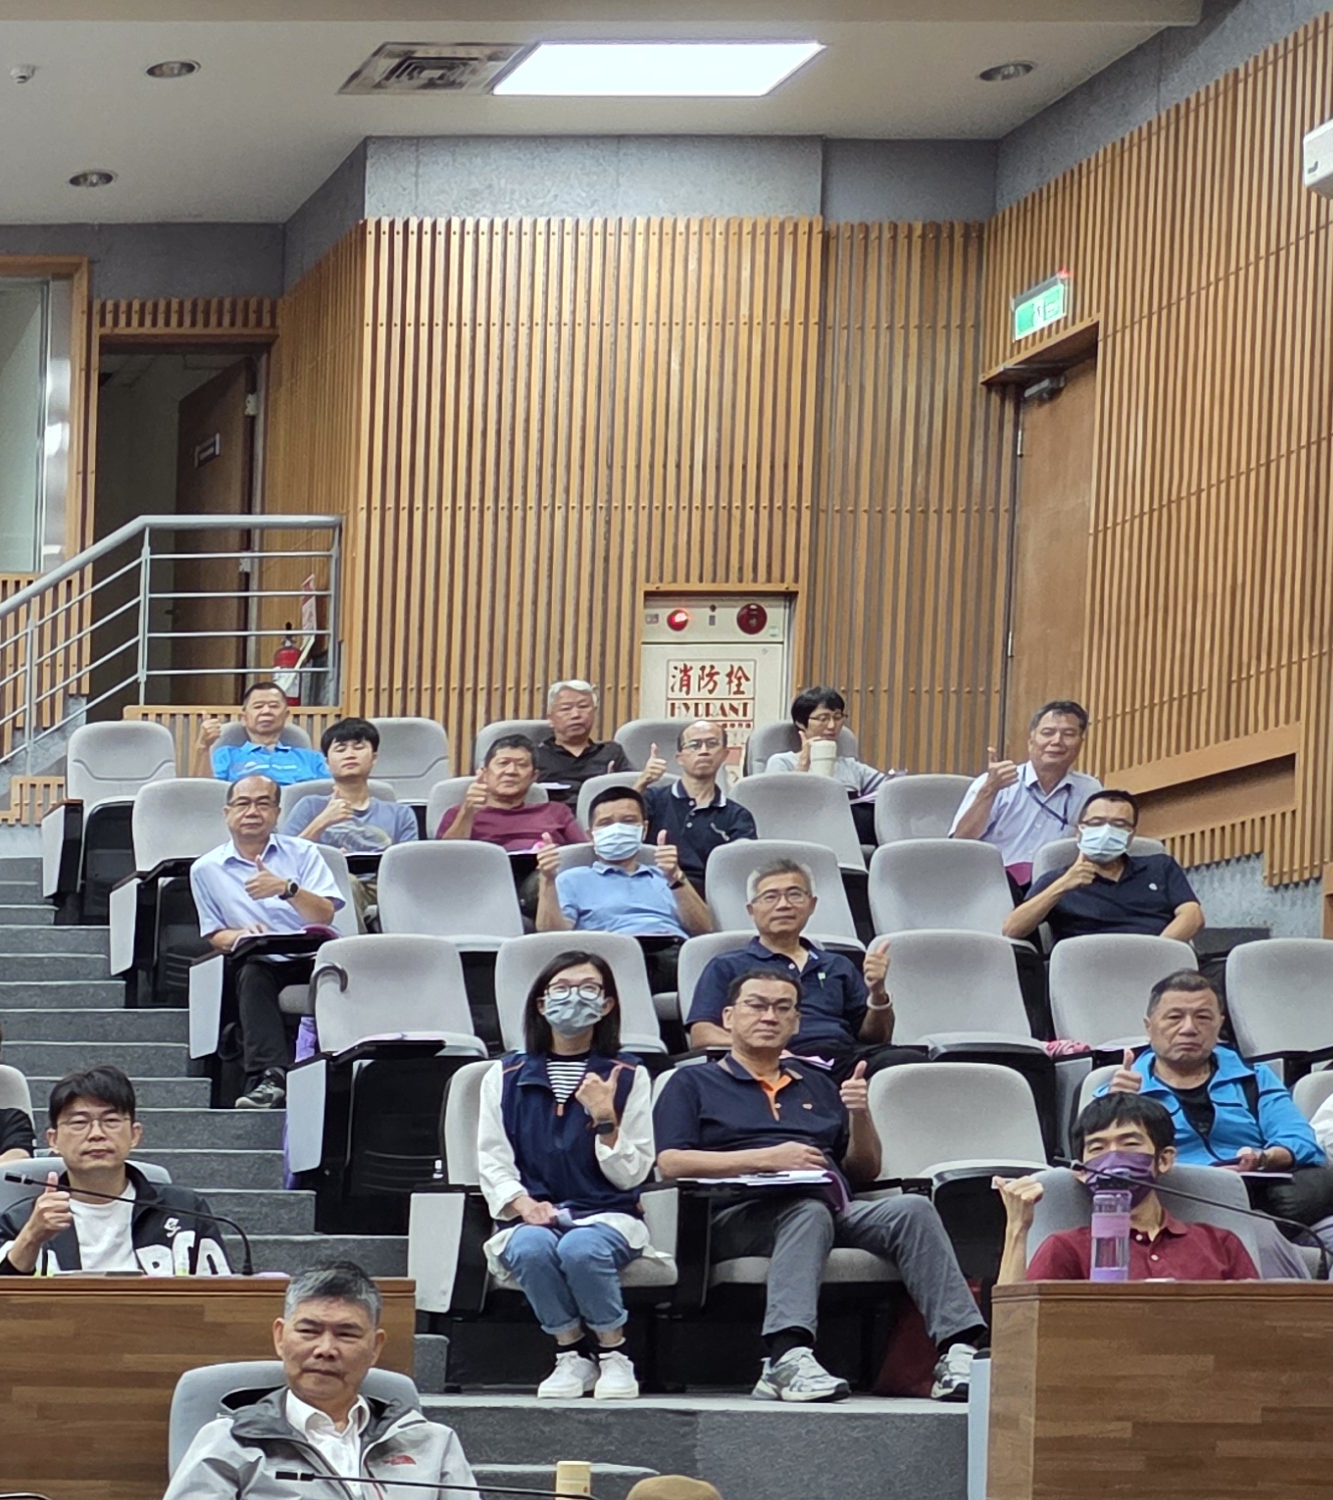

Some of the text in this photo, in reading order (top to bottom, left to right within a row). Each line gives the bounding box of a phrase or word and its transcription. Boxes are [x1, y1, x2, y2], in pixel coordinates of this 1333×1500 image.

[670, 663, 751, 696] 消防栓
[670, 702, 748, 718] HYDRANT
